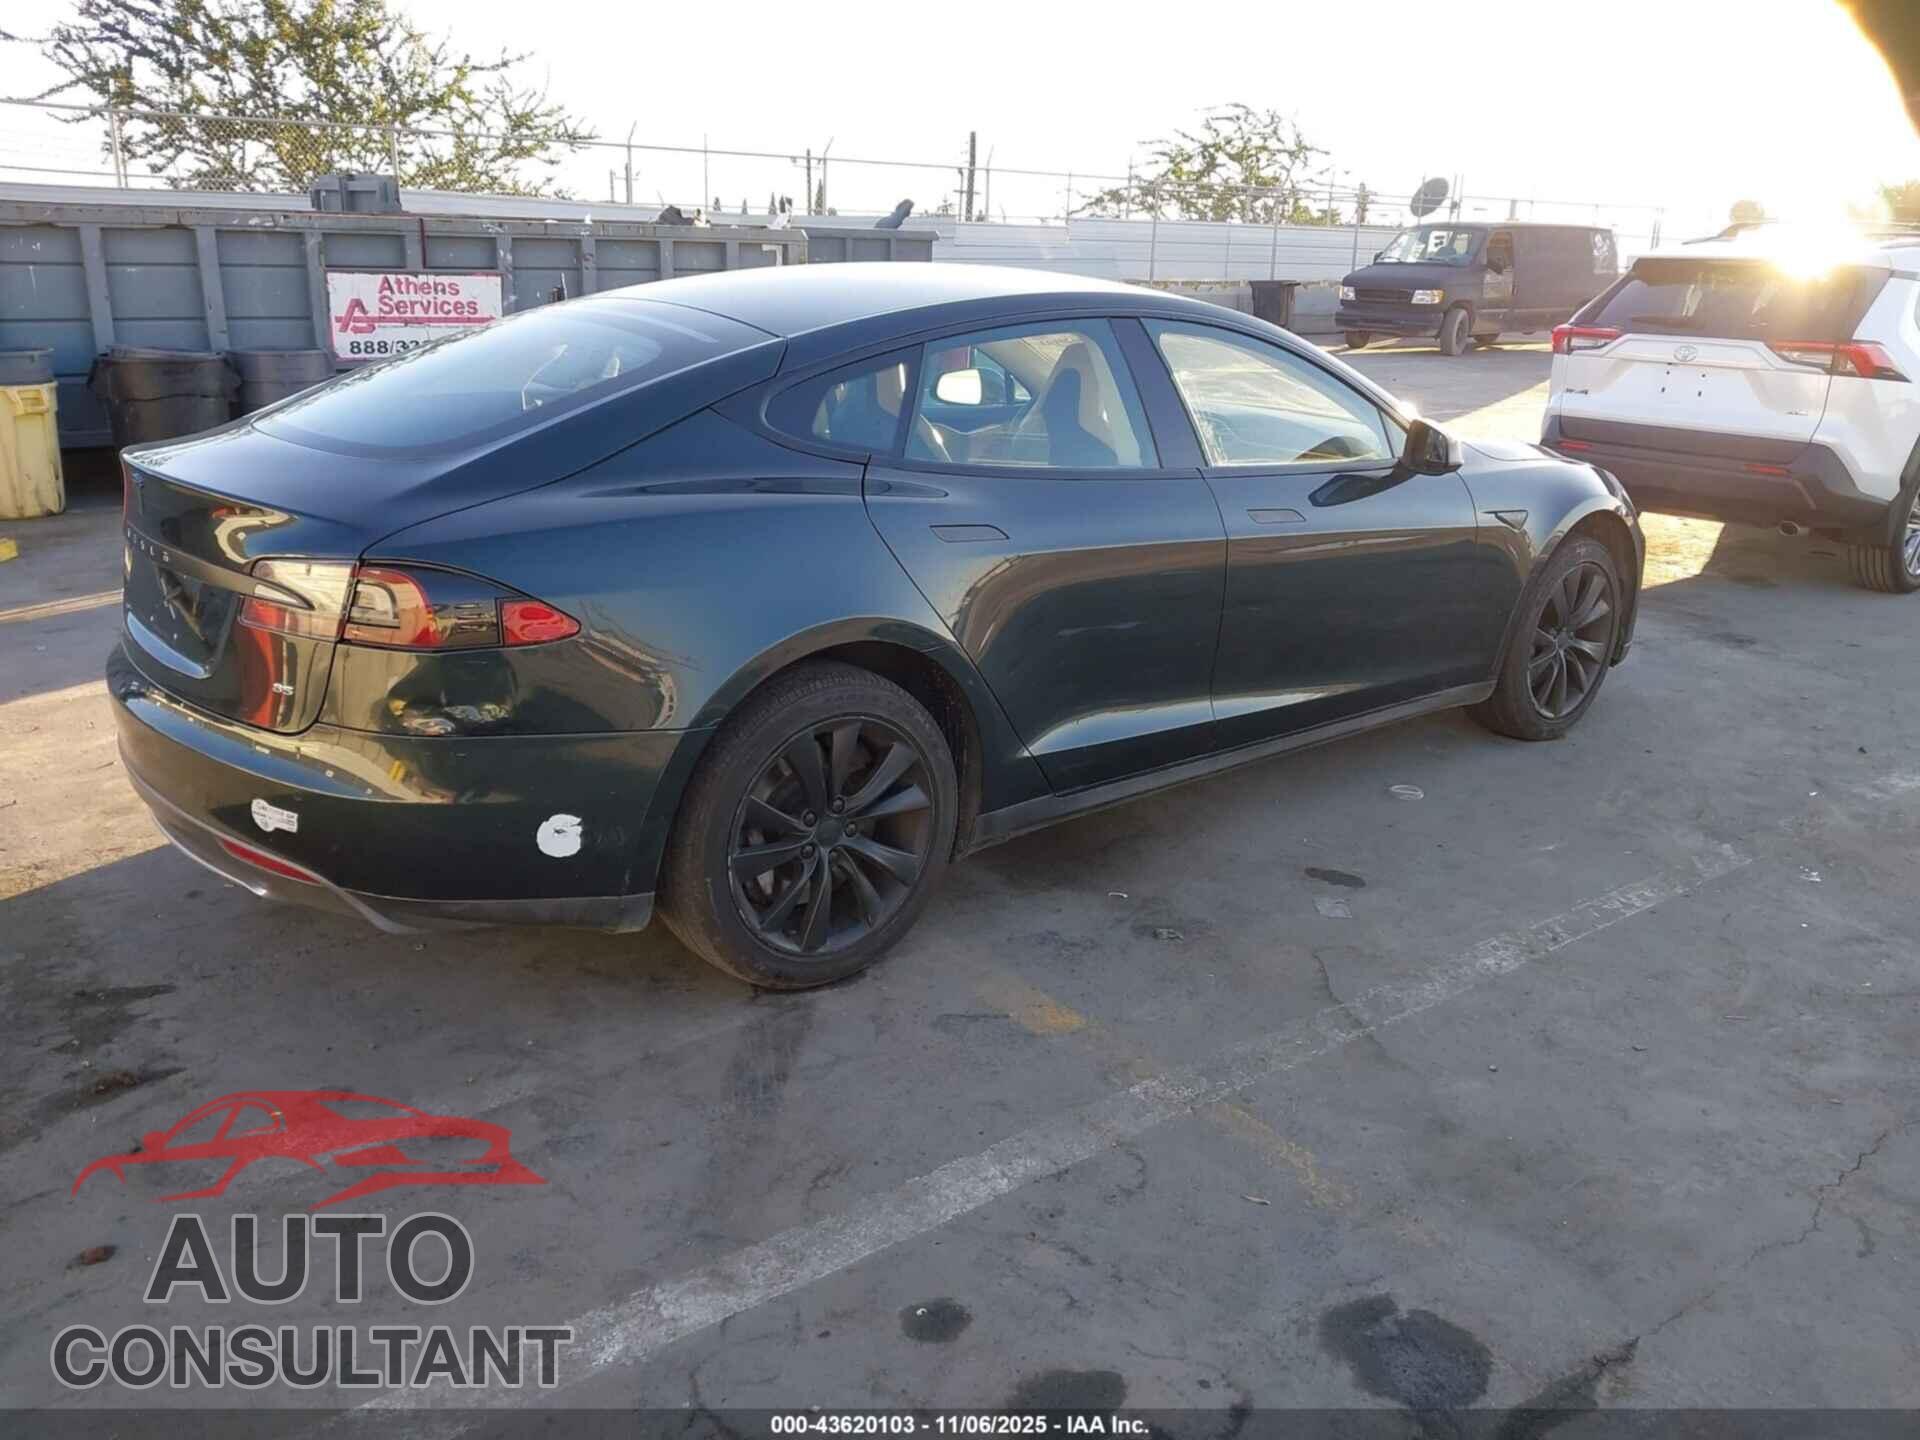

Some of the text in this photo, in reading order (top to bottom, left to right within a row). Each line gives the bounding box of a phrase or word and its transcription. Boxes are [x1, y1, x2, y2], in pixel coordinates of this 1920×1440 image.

[378, 275, 460, 296] Athens
[378, 295, 479, 315] Services
[350, 339, 430, 354] 888/3
